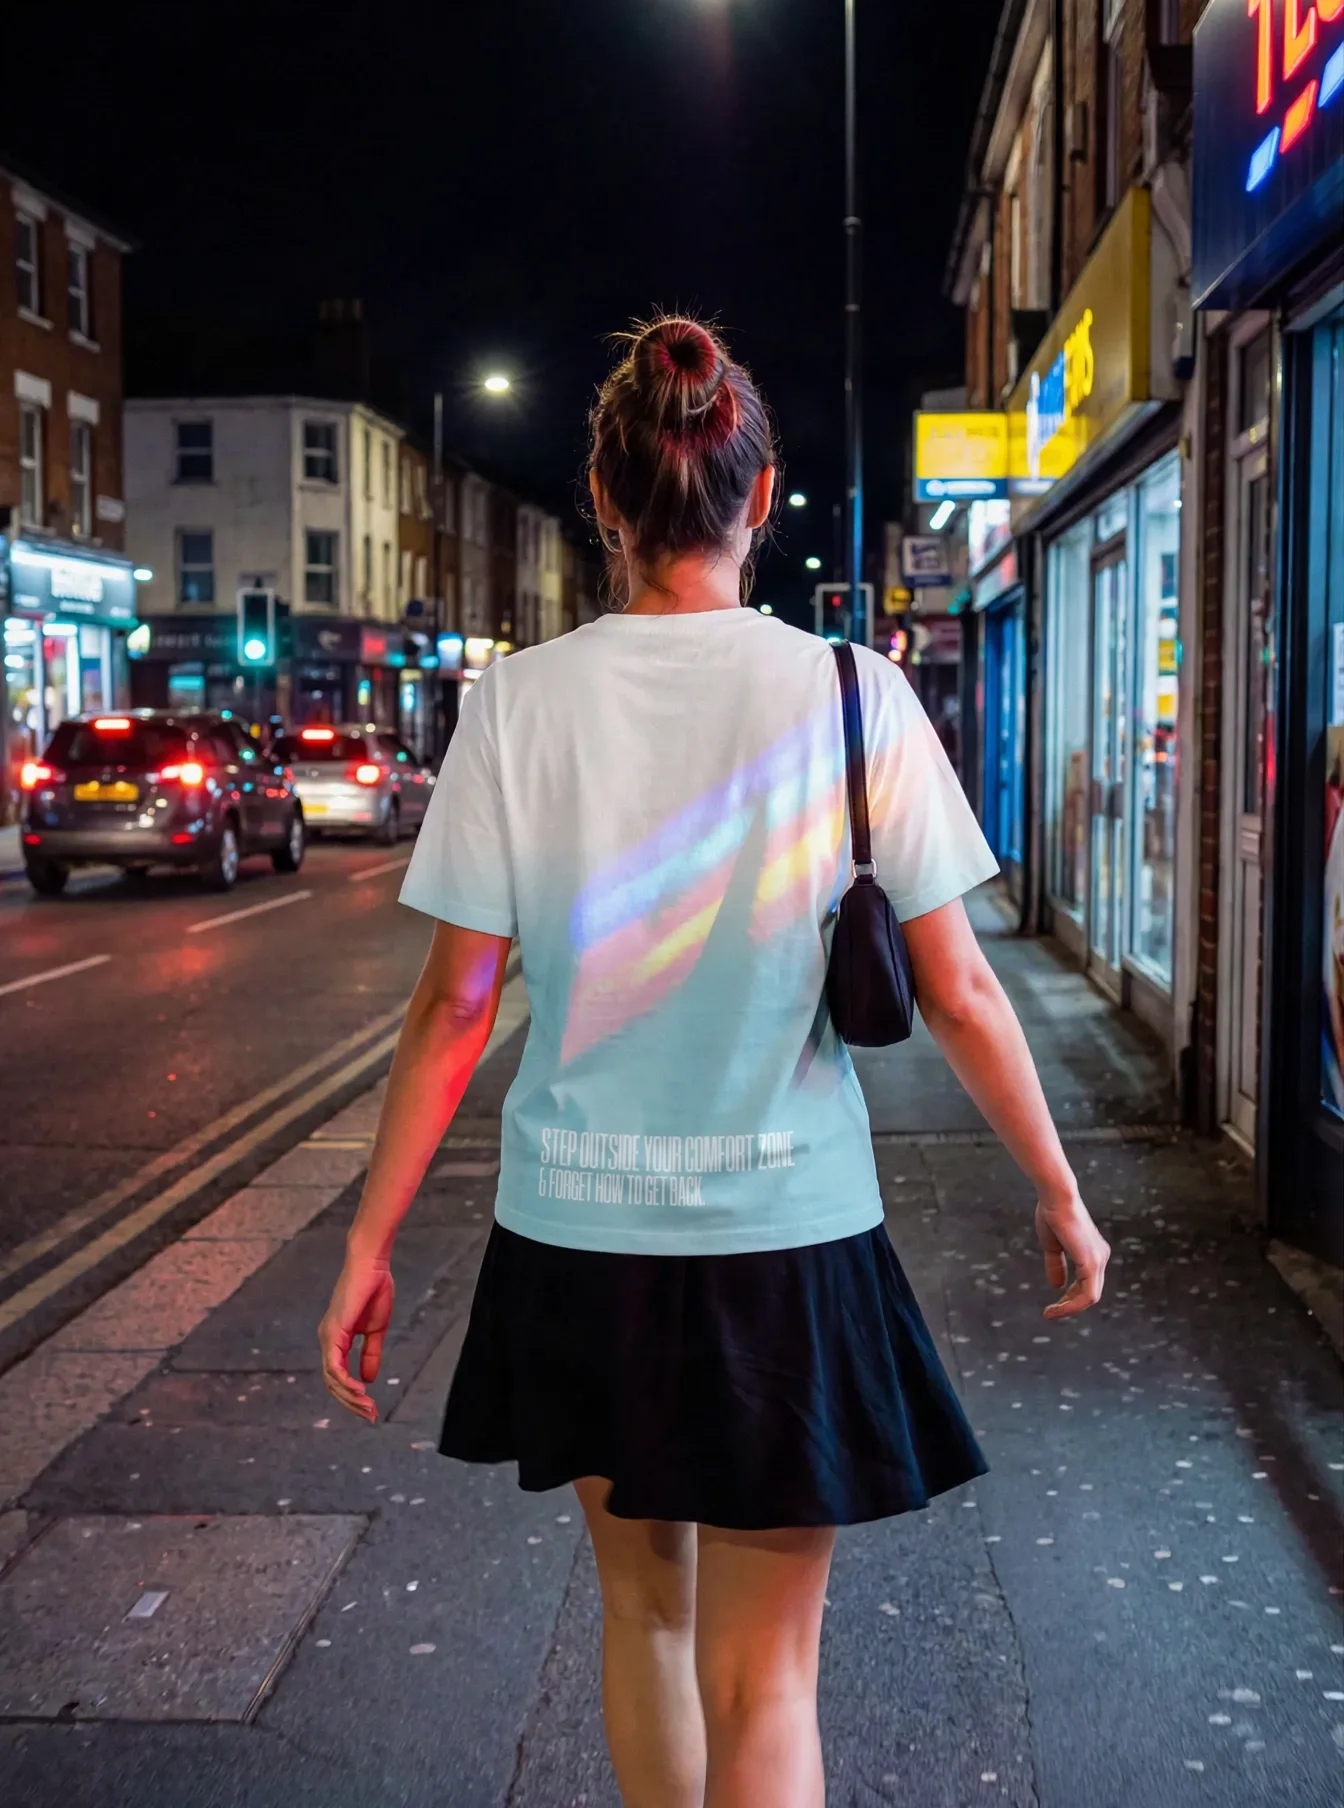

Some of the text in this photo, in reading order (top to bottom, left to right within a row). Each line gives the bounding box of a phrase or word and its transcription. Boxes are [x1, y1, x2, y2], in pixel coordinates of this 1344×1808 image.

[541, 1127, 795, 1173] STEP OUTSIDE YOUR COMFORT ZONE
[538, 1167, 546, 1197] &
[549, 1168, 592, 1202] FORGET
[595, 1173, 624, 1204] HOW
[627, 1174, 642, 1205] TO
[645, 1174, 668, 1206] GET
